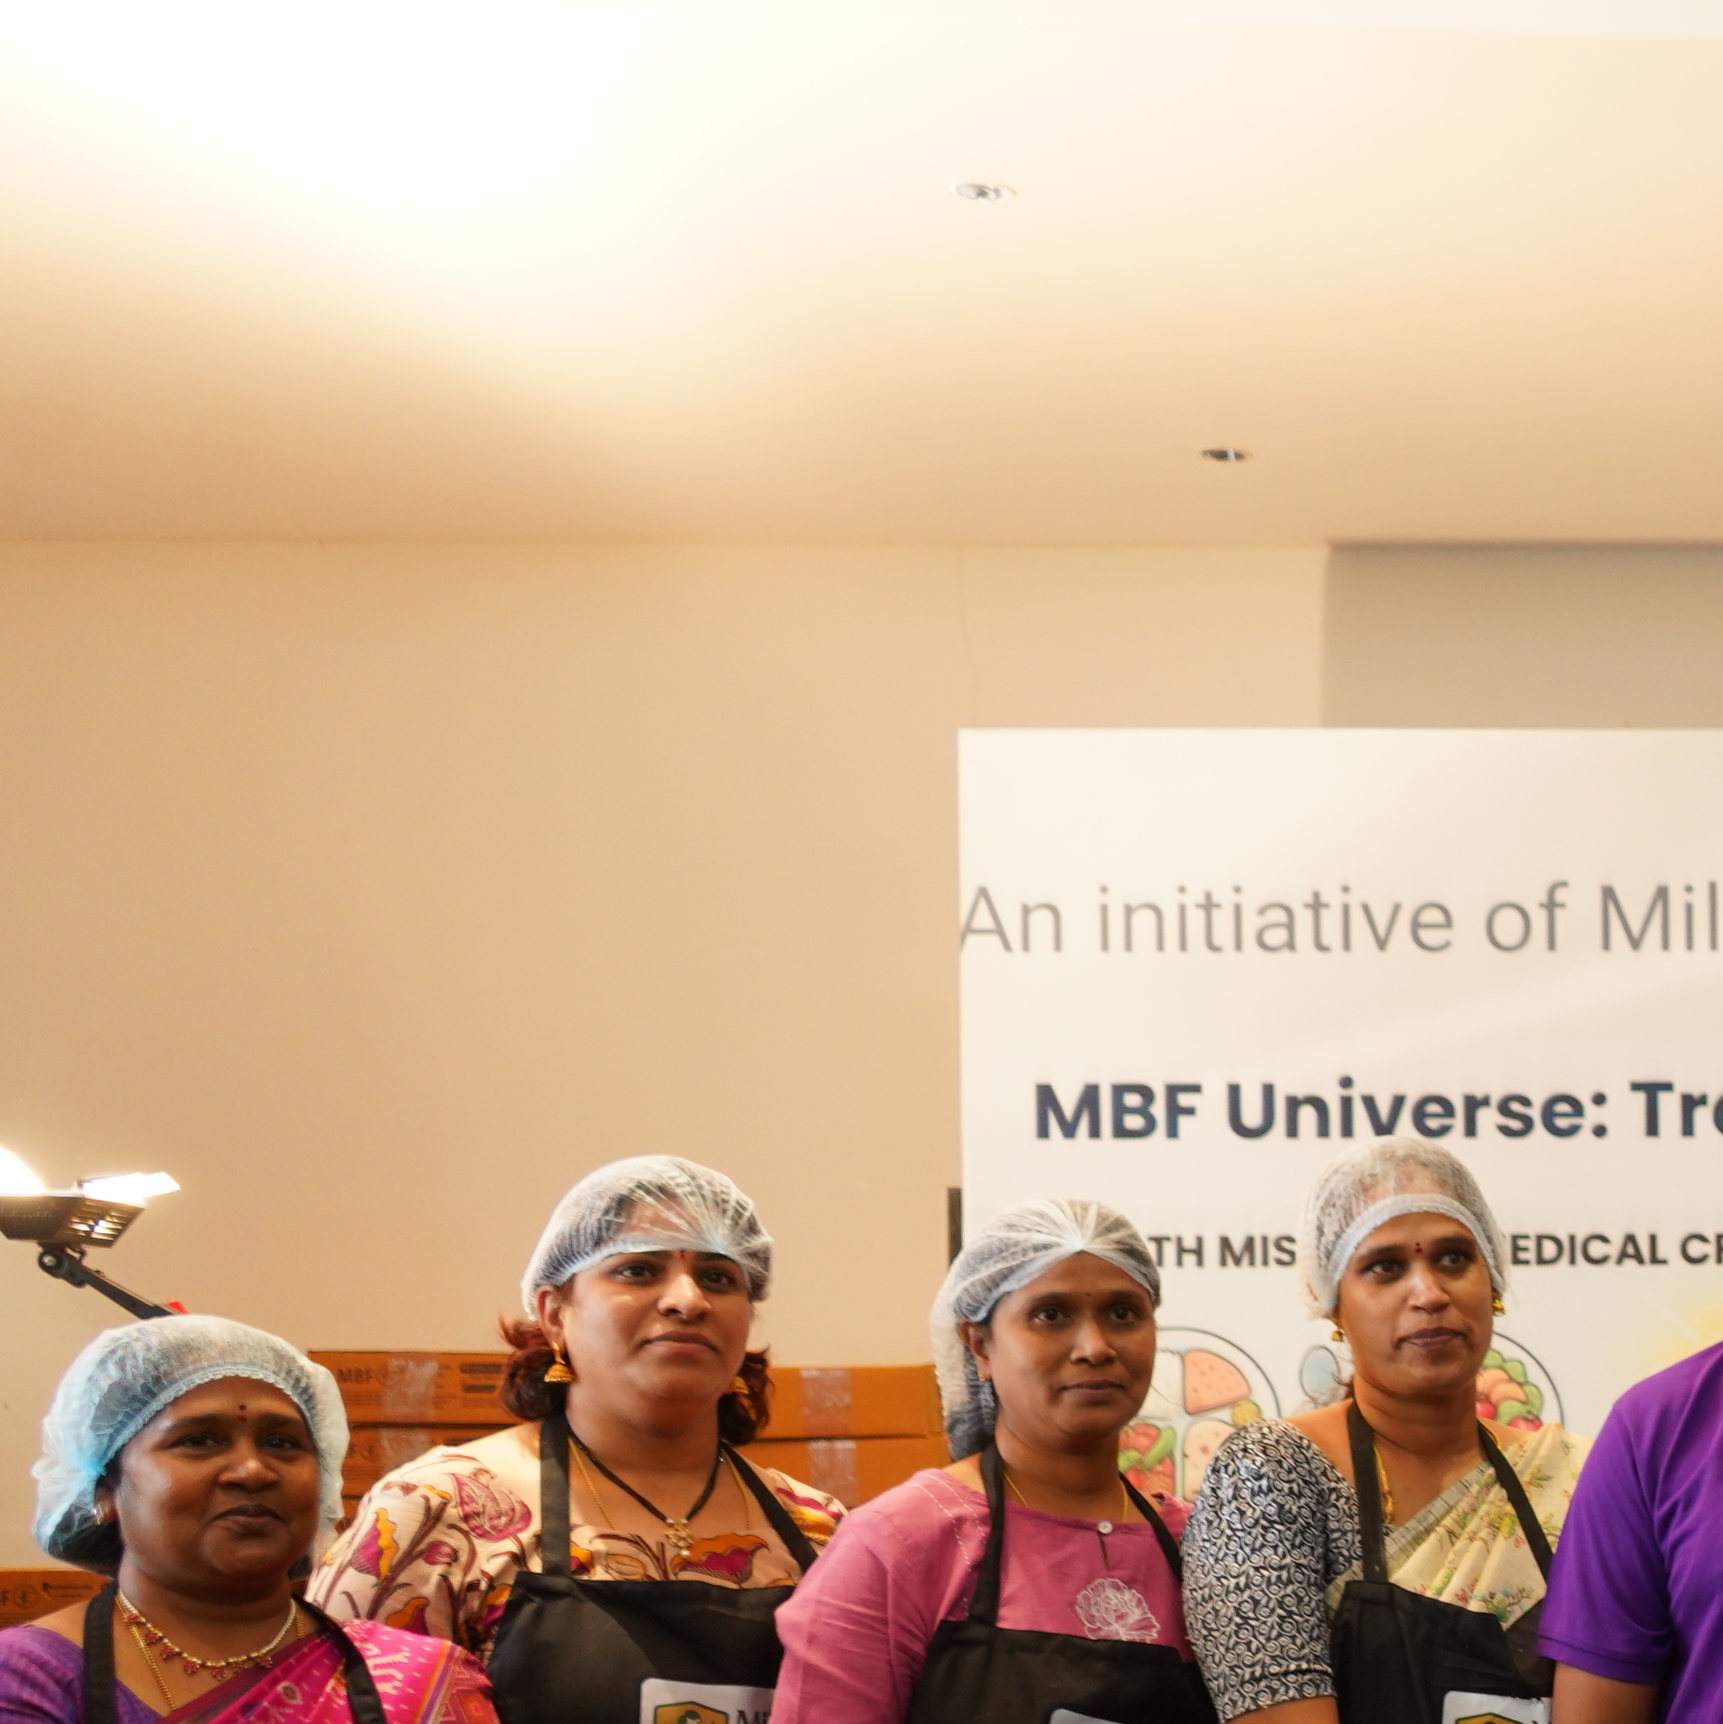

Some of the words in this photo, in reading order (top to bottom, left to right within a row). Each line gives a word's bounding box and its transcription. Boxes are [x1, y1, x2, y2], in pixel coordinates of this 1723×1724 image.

[959, 885, 1064, 953] An
[1100, 884, 1454, 954] initiative
[1485, 880, 1570, 953] of
[1034, 1082, 1203, 1140] MBF
[1226, 1075, 1609, 1140] Universe:
[1510, 1232, 1669, 1267] EDICAL
